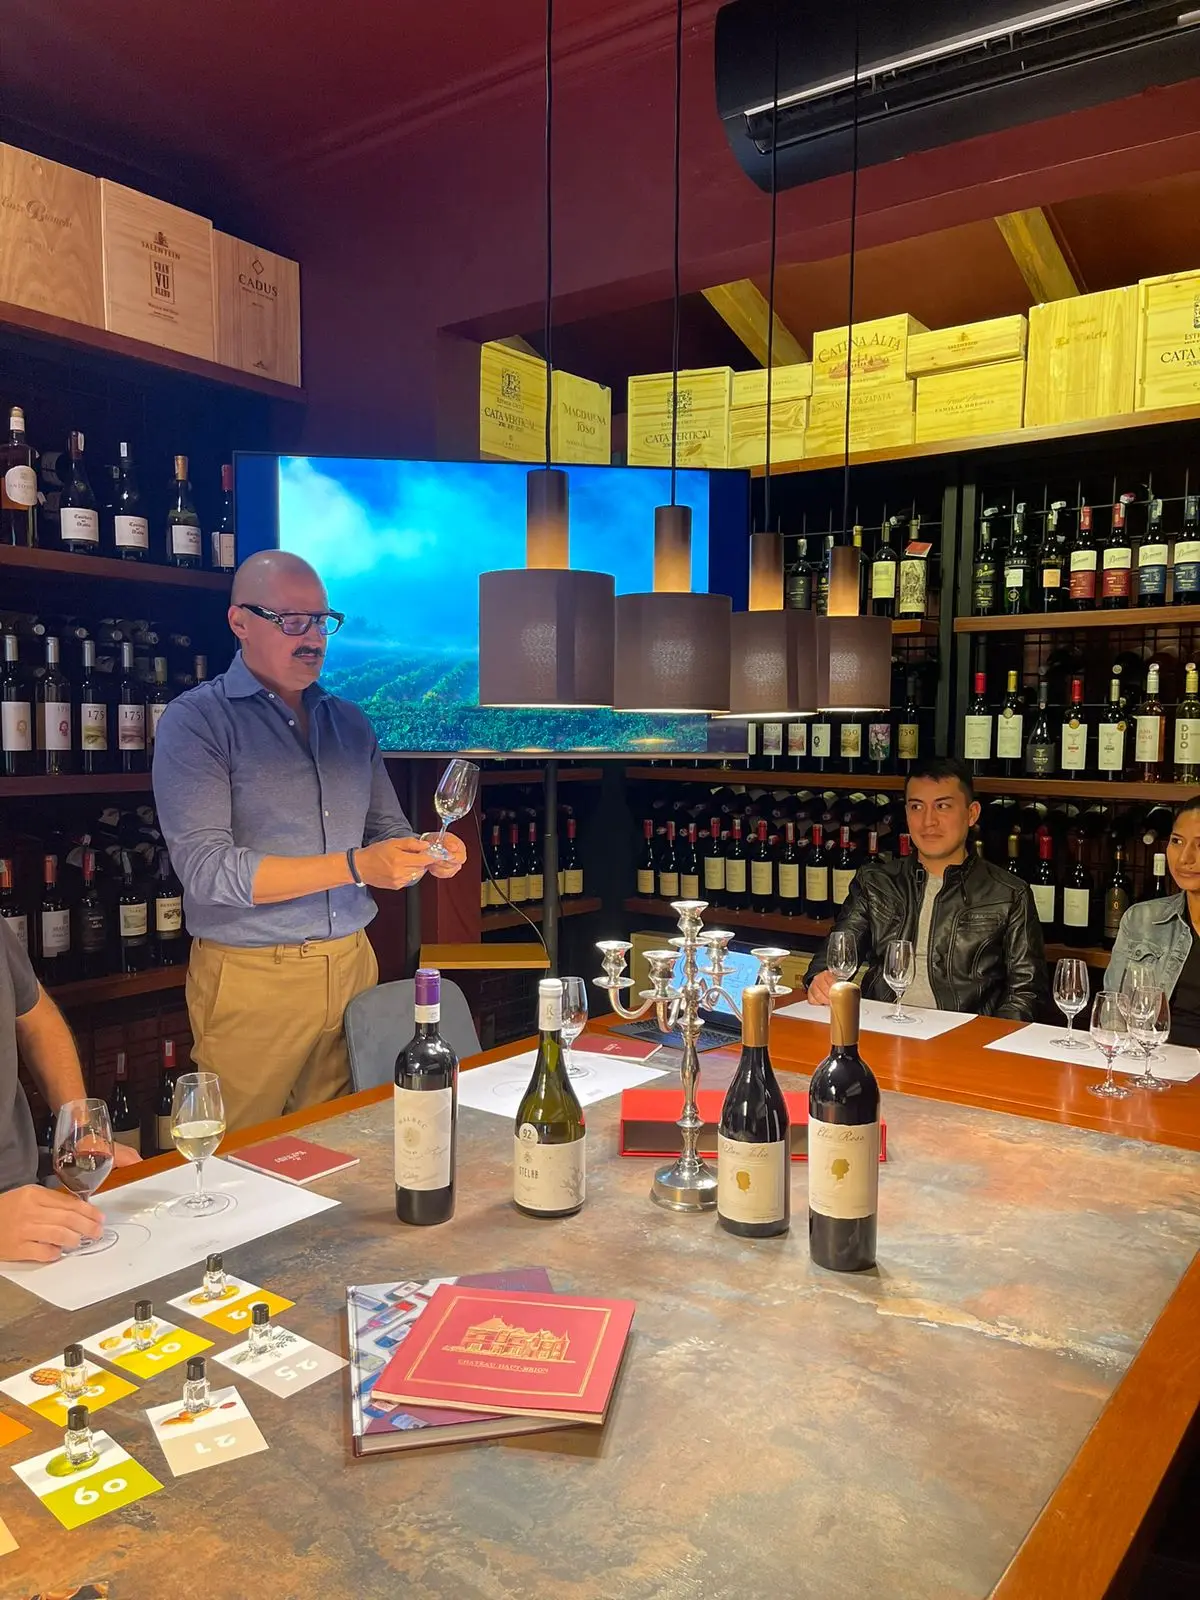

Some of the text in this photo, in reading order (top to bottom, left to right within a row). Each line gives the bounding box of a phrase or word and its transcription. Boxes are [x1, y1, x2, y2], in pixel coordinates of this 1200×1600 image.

[141, 241, 181, 260] SALENTEIN
[154, 261, 169, 275] GRAN
[156, 271, 169, 290] VU
[238, 274, 278, 297] CADUS
[870, 332, 900, 351] ALTA
[1160, 347, 1196, 364] CATA
[484, 406, 505, 420] CATA
[504, 412, 537, 432] VERTICAL
[576, 421, 596, 436] TOSO
[644, 432, 670, 445] CATA
[672, 429, 712, 443] ERTICAL
[1180, 723, 1189, 750] DUO
[523, 1128, 532, 1140] 92
[274, 1358, 319, 1382] 25
